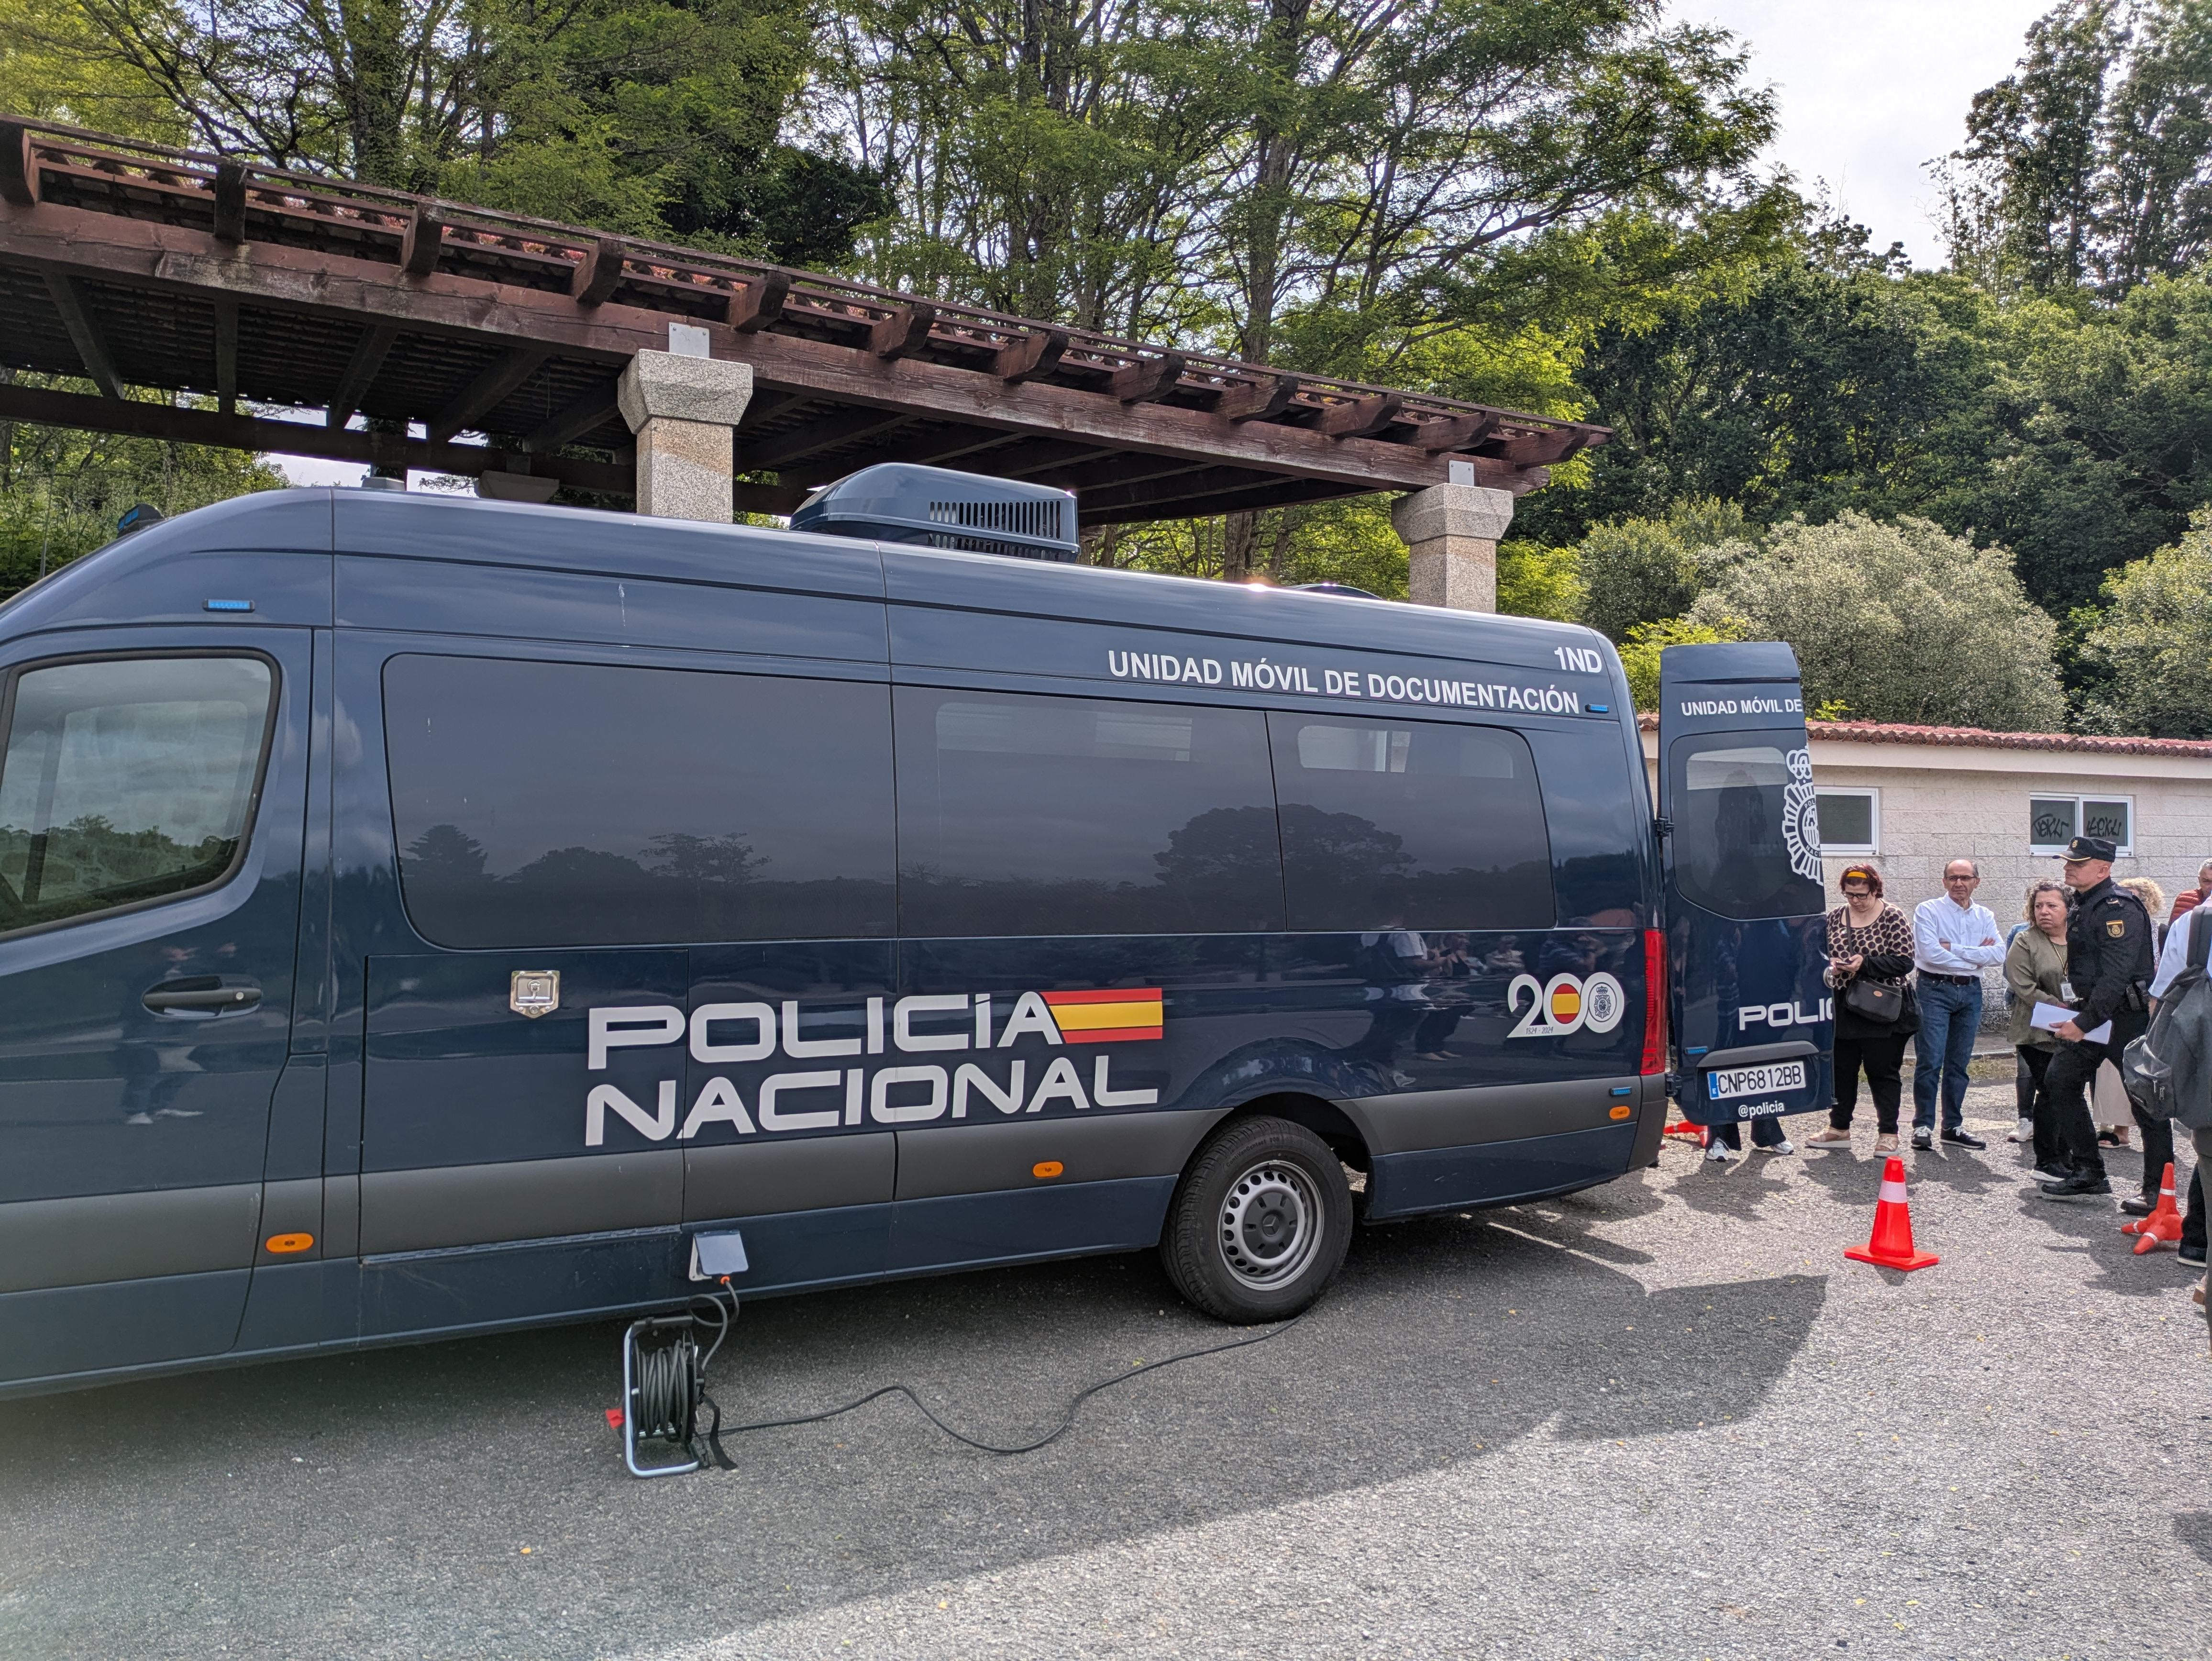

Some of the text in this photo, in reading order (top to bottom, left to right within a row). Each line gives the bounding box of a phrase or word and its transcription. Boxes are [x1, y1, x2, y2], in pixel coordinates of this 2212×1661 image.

[1554, 646, 1602, 673] 1ND
[1108, 650, 1580, 714] UNIDAD MÓVIL DE DOCUMENTACIÓN
[1681, 696, 1803, 716] UNIDAD MÓVIL DE
[1506, 972, 1625, 1038] 200
[1718, 1065, 1802, 1094] CNP6812BB
[586, 1055, 1158, 1146] NACIONAL
[1738, 1100, 1785, 1118] @policia
